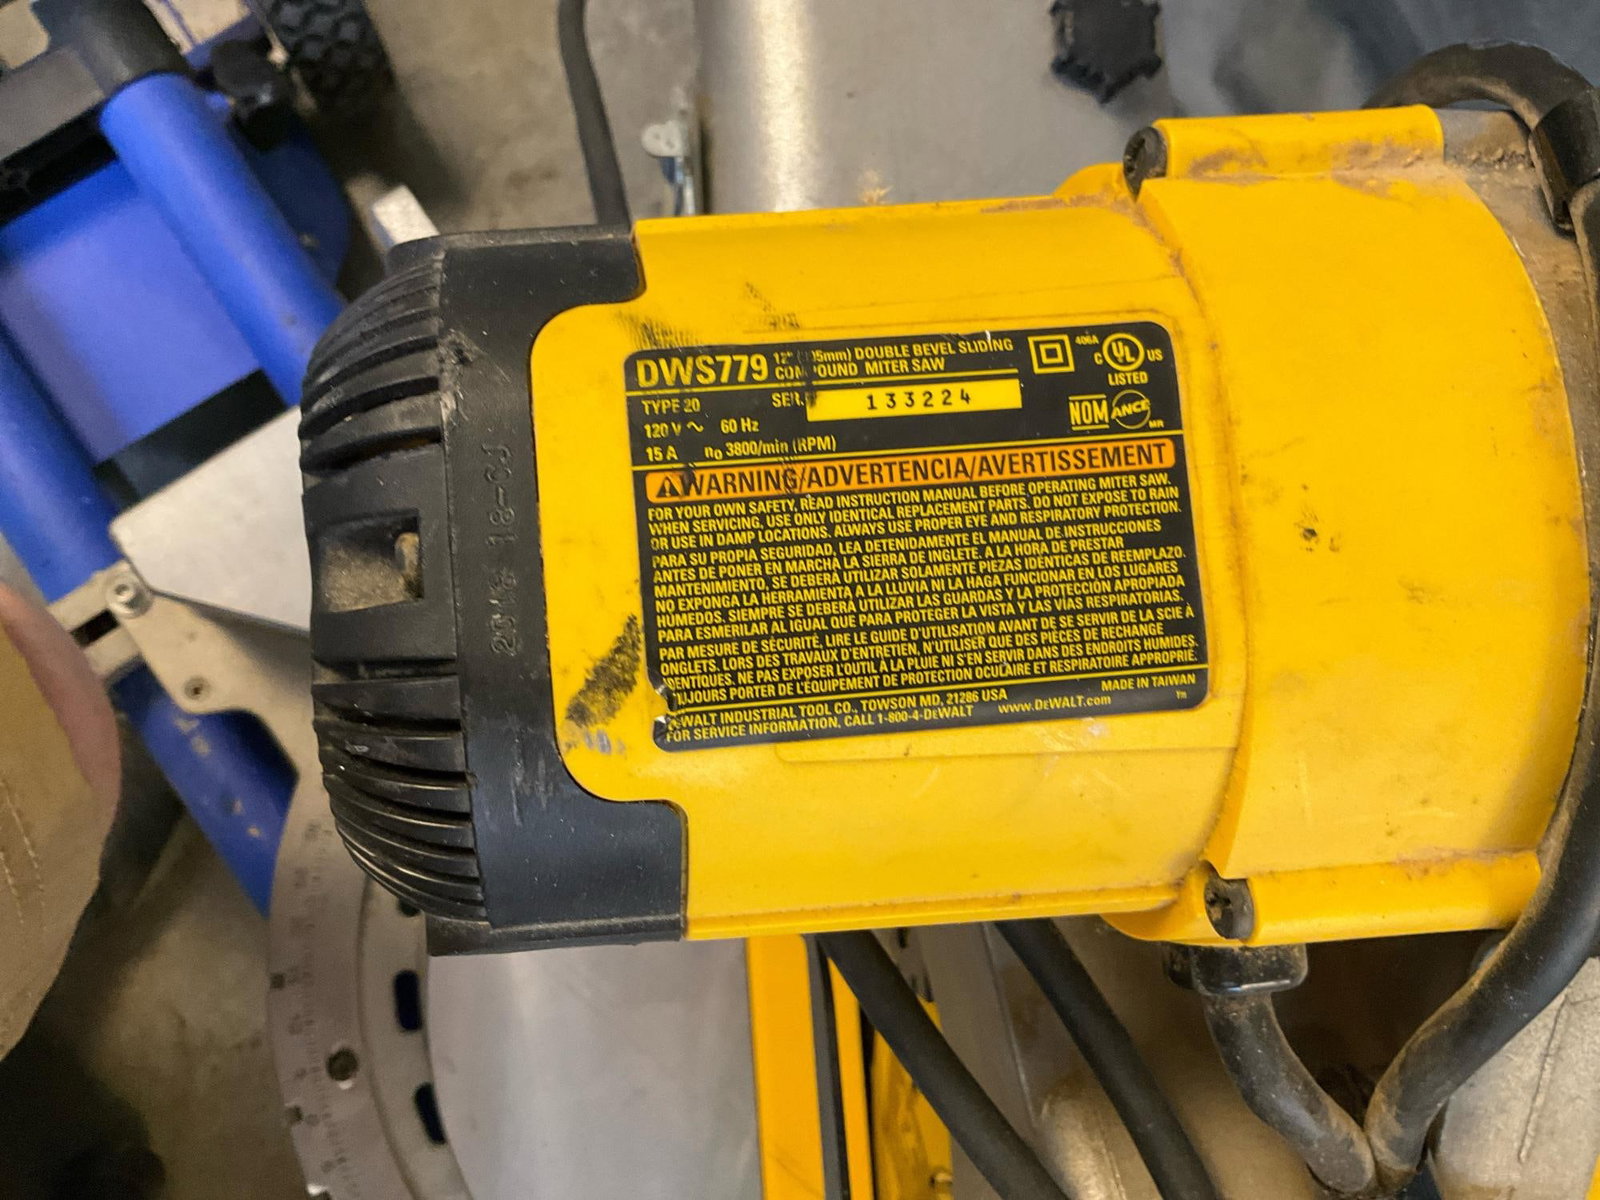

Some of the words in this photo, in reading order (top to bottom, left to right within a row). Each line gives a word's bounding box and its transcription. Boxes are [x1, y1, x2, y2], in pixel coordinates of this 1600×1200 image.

[854, 344, 909, 359] DOUBLE
[912, 341, 956, 356] BEVEL
[957, 338, 1014, 353] SLIDING
[1093, 352, 1103, 364] C
[1111, 340, 1135, 363] UL
[1146, 348, 1163, 361] US
[636, 352, 769, 387] DWS779
[774, 362, 858, 380] COMOUND
[864, 359, 909, 374] MITER
[911, 356, 945, 371] SAW
[1107, 371, 1148, 386] LISTED
[641, 397, 681, 415] TYPE
[683, 397, 700, 412] 20
[866, 388, 971, 410] 133224
[1069, 399, 1109, 425] NOM
[1109, 398, 1151, 419] ANCE
[643, 422, 668, 438] 120
[670, 421, 682, 436] V
[720, 418, 736, 433] 60
[740, 416, 759, 432] Hz
[645, 445, 663, 462] 15
[664, 445, 678, 460] A
[724, 437, 788, 458] 3800/min
[791, 435, 837, 454] (RPM)
[647, 506, 672, 521] FOR
[675, 504, 710, 519] YOUR
[713, 502, 745, 516] OWN
[748, 498, 797, 515] SAFETY,
[799, 495, 833, 510] READ
[836, 490, 920, 507] INSTRUCTION
[922, 486, 977, 501] MANUAL
[979, 482, 1025, 497] BEFORE
[1027, 477, 1096, 494] OPERATING
[1098, 474, 1137, 489] MITER
[1139, 472, 1170, 486] SAW.
[648, 520, 689, 535] WHEN
[692, 515, 763, 533] SERVICING,
[766, 513, 791, 527] USE
[793, 511, 826, 525] ONLY
[829, 506, 894, 523] IDENTICAL
[896, 500, 985, 518] REPLACEMENT
[987, 496, 1030, 511] PARTS.
[1032, 495, 1050, 508] DO
[1053, 493, 1079, 506] NOT
[1081, 489, 1128, 504] EXPOSE
[1130, 488, 1146, 501] TO
[1148, 486, 1178, 499] RAIN
[650, 536, 668, 550] OR
[671, 534, 696, 549] USE
[699, 533, 713, 546] IN
[716, 530, 755, 545] DAMP
[757, 525, 831, 542] LOCATIONS.
[833, 521, 885, 537] ALWAYS
[887, 519, 912, 533] USE
[914, 516, 962, 531] PROPER
[965, 514, 987, 527] EYE
[989, 511, 1017, 526] AND
[1019, 506, 1101, 523] RESPIRATORY
[1103, 500, 1180, 517] PROTECTION.
[652, 553, 686, 568] PARA
[689, 552, 706, 565] SU
[710, 548, 757, 563] PROPIA
[839, 540, 861, 554] LEA
[865, 533, 969, 552] DETENIDAMENTE
[988, 527, 1042, 543] MANUAL
[1045, 525, 1061, 539] DE
[1063, 518, 1161, 537] INSTRUCCIONES
[654, 577, 768, 598] MANTENIMIENTO,
[771, 575, 787, 589] SE
[790, 569, 840, 587] DEBERÁ
[842, 567, 898, 583] UTILIZAR
[900, 561, 976, 578] SOLAMENTE
[978, 557, 1022, 573] PIEZAS
[1091, 551, 1108, 564] DE
[1110, 545, 1185, 562] REEMPLAZO.
[728, 605, 784, 622] SIEMPRE
[787, 603, 803, 617] SE
[805, 597, 856, 615] DEBERÁ
[858, 595, 914, 611] UTILIZAR
[916, 593, 940, 607] LAS
[942, 588, 1003, 605] GUARDAS
[1005, 587, 1014, 599] Y
[1016, 586, 1032, 599] LA
[1034, 577, 1111, 597] PROTECCIÓN
[1113, 574, 1184, 591] APROPIADA
[657, 627, 693, 642] PARA
[695, 621, 768, 639] ESMERILAR
[770, 620, 787, 633] AL
[789, 617, 828, 632] IGUAL
[830, 614, 856, 628] QUE
[858, 611, 892, 626] PARA
[894, 606, 958, 623] PROTEGER
[961, 605, 977, 618] LA
[978, 602, 1015, 616] VISTA
[1017, 601, 1026, 613] Y
[1028, 599, 1052, 613] LAS
[1085, 588, 1183, 608] RESPIRATORIAS.
[660, 658, 719, 676] ONGLETS.
[722, 655, 753, 670] LORS
[755, 653, 780, 668] DES
[782, 648, 838, 665] TRAVAUX
[840, 641, 920, 662] D'ENTRETIEN,
[922, 636, 985, 653] N'UTILISER
[988, 634, 1012, 648] QUE
[1014, 632, 1038, 646] DES
[1039, 626, 1080, 644] PIÈCES
[1082, 627, 1098, 641] DE
[1100, 622, 1163, 639] RECHANGE
[729, 684, 775, 700] PORTER
[777, 682, 793, 696] DE
[795, 672, 880, 694] L'ÉQUIPEMENT
[882, 673, 898, 686] DE
[900, 667, 972, 685] PROTECTION
[974, 662, 1031, 679] OCULAIRE
[1032, 660, 1047, 674] ET
[1049, 654, 1129, 672] RESPIRATOIRE
[1130, 646, 1197, 665] APPROPRIÉ.
[1101, 678, 1133, 691] MADE
[1136, 676, 1148, 688] IN
[1151, 672, 1195, 687] TAIWAN
[720, 705, 796, 724] INDUSTRIAL
[798, 702, 831, 717] TOOL
[860, 695, 916, 712] TOWSON
[946, 690, 978, 704] 21286
[981, 687, 1007, 701] USA
[665, 728, 690, 742] FOR
[693, 723, 746, 740] SERVICE
[843, 713, 874, 727] CALL
